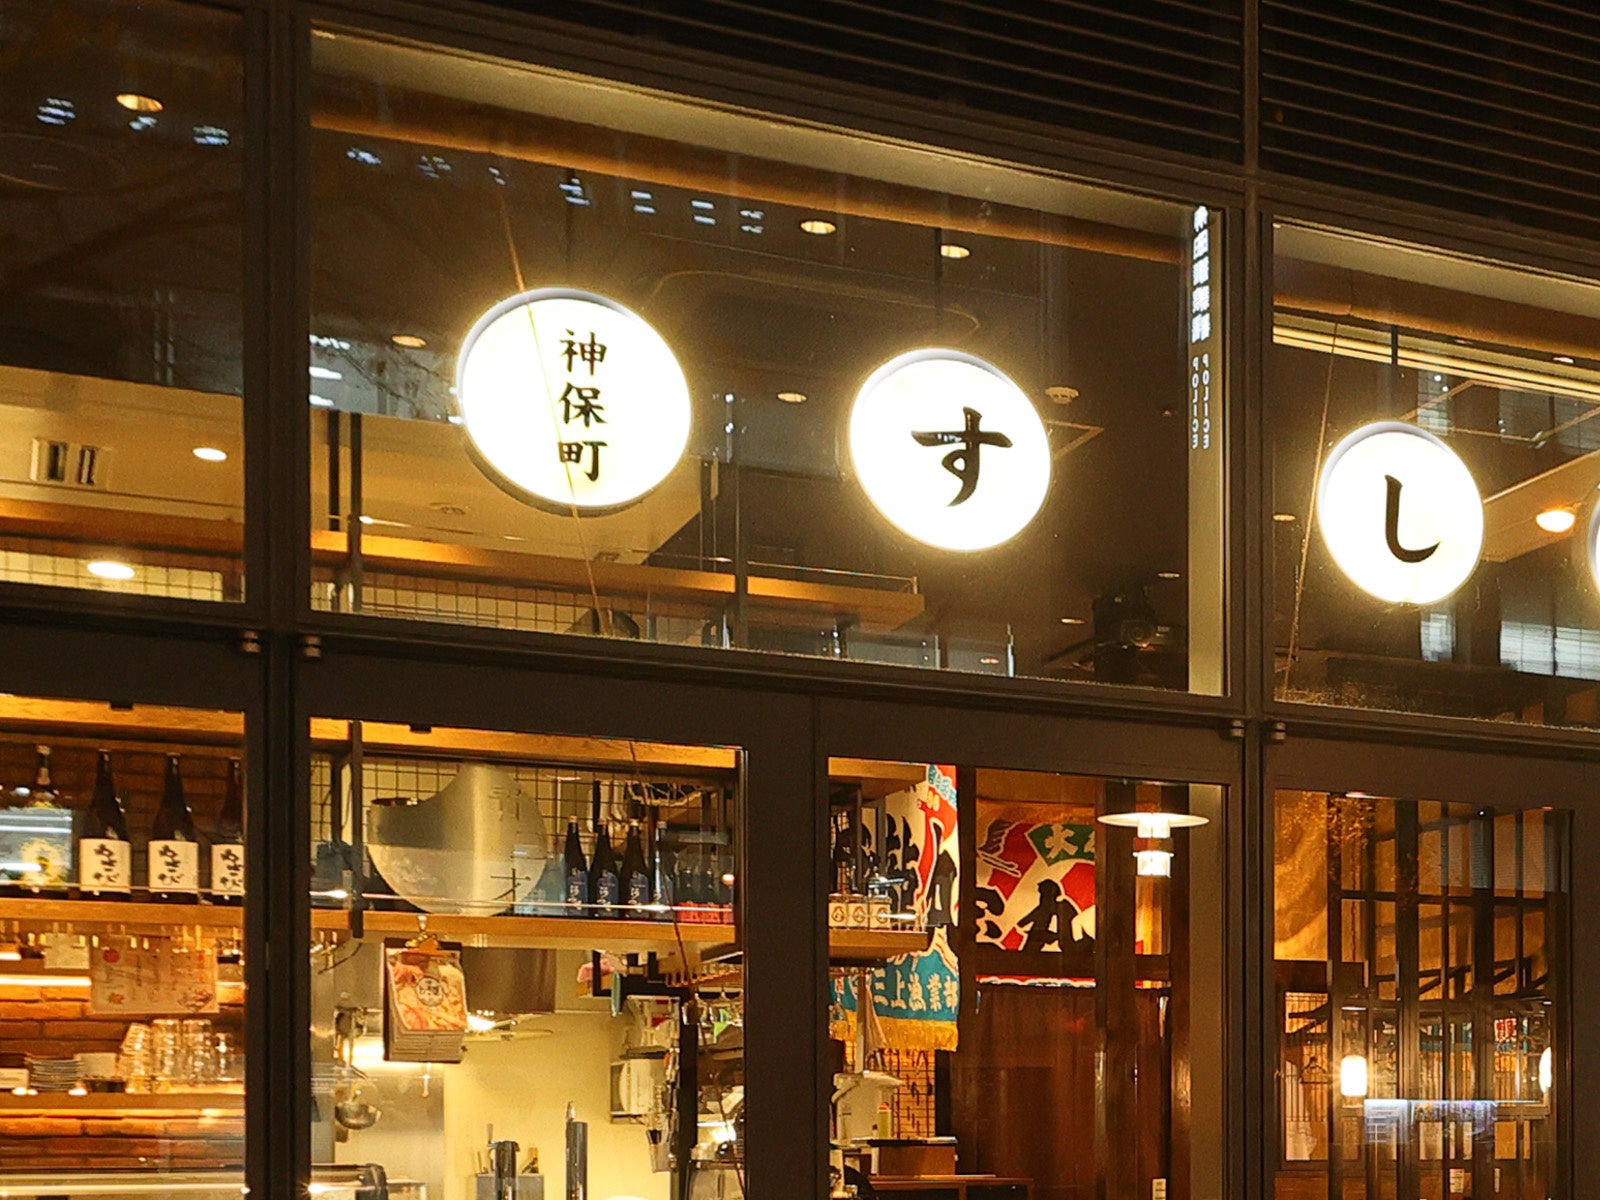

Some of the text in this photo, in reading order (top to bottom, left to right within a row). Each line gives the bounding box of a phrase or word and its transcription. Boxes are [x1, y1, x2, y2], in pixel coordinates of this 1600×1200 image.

[558, 328, 608, 482] 神保町
[910, 405, 1014, 508] す
[1385, 474, 1441, 563] し
